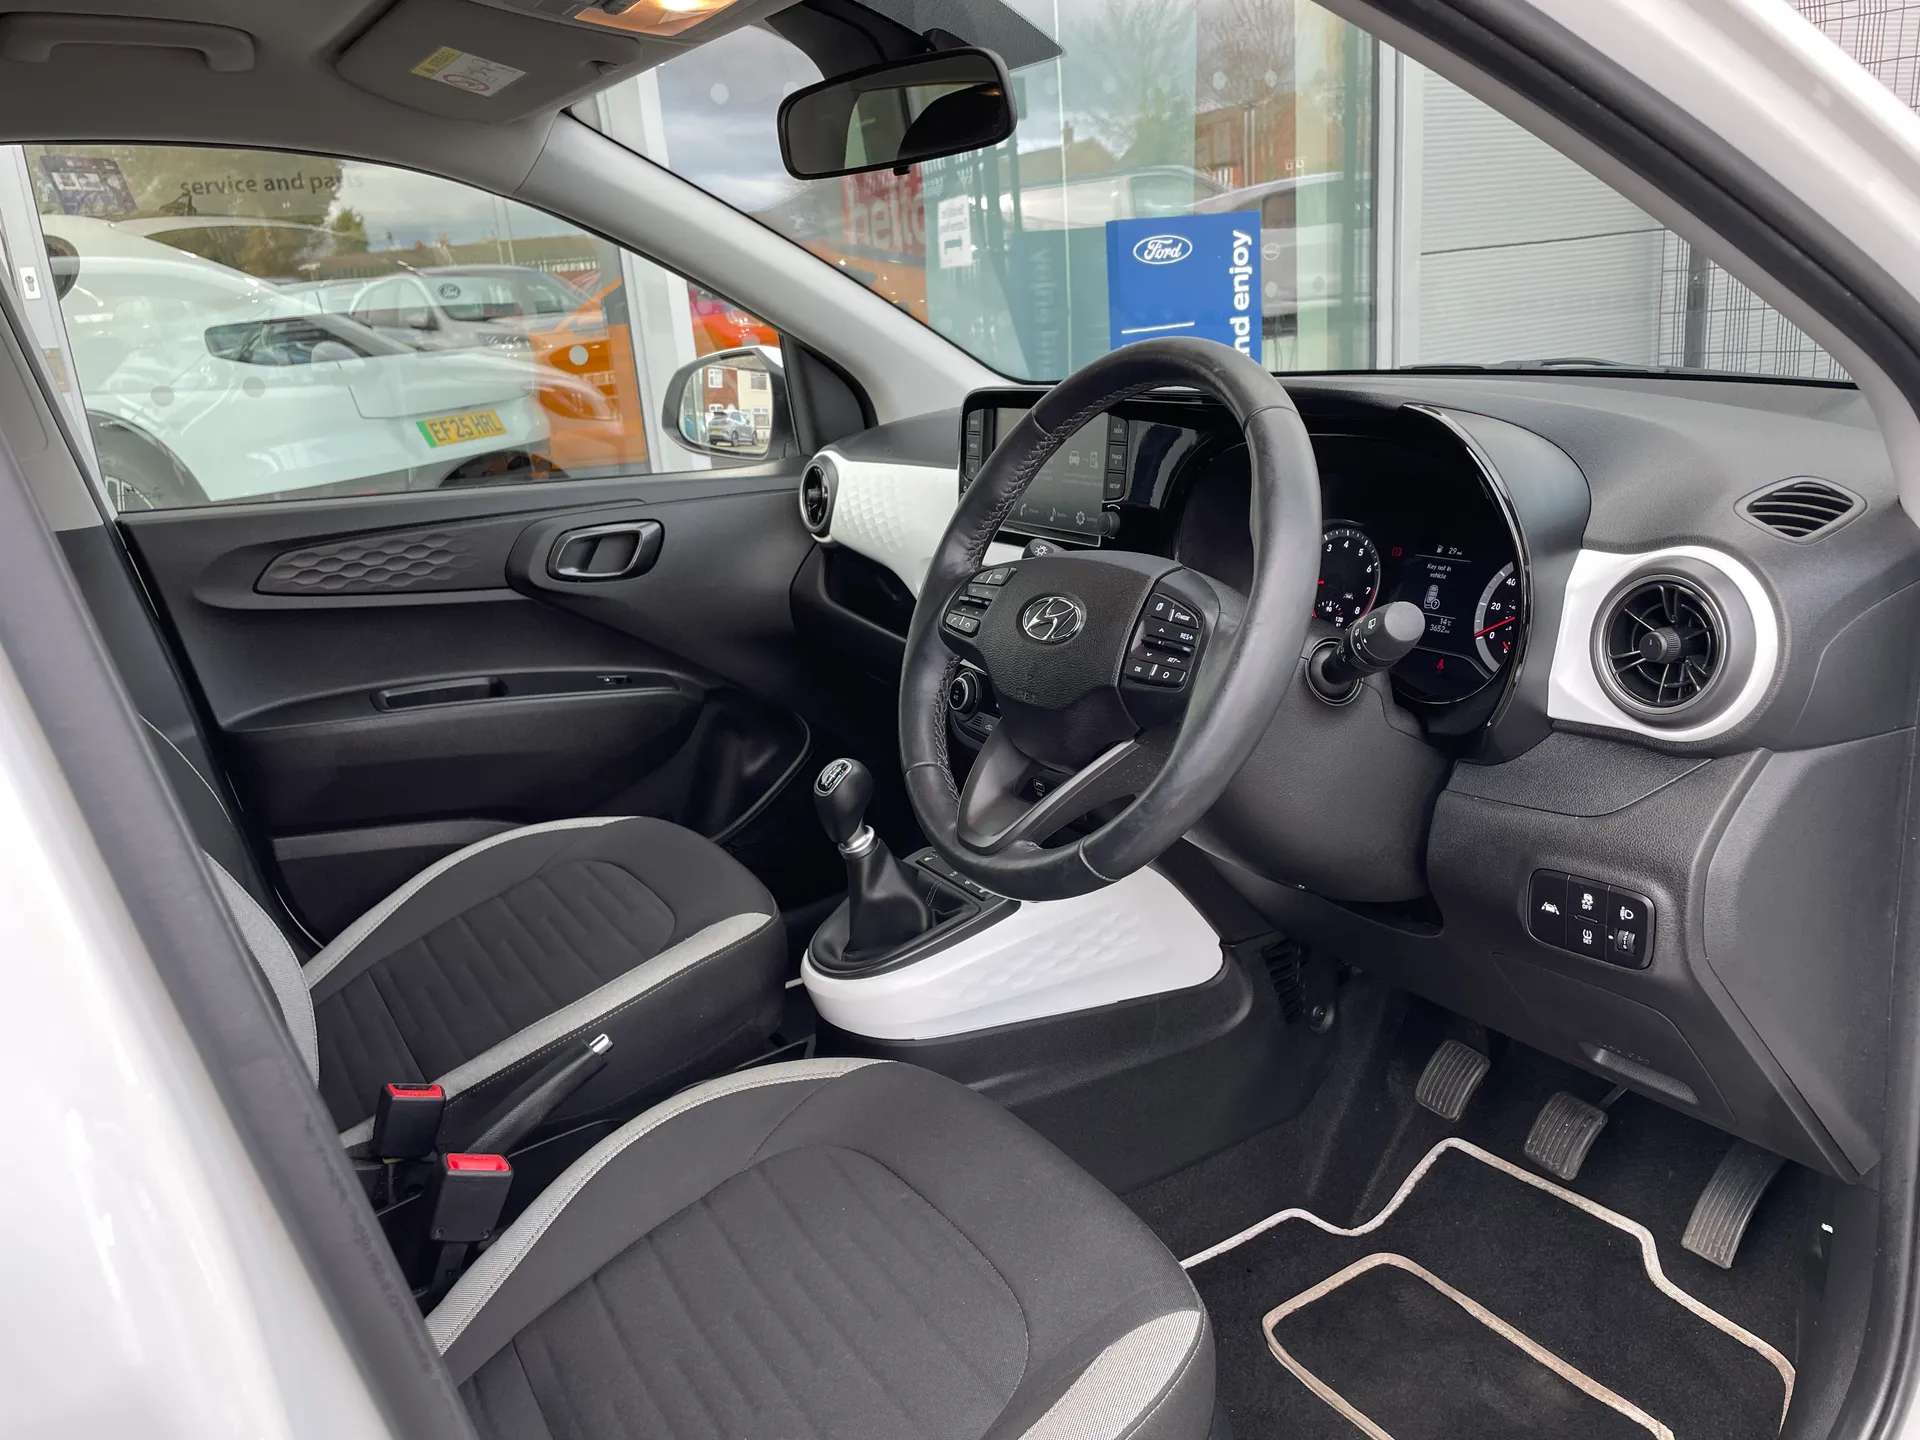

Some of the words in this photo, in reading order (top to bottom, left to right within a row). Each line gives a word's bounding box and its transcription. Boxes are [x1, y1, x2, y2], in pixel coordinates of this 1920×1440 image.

[180, 175, 258, 196] service
[263, 172, 304, 192] and
[1228, 229, 1253, 311] enjoy
[1229, 316, 1251, 357] nd
[429, 417, 474, 441] EF25
[1326, 543, 1333, 552] 3
[1343, 540, 1350, 548] 4
[1358, 548, 1364, 557] 5
[1366, 564, 1372, 573] 6
[1426, 563, 1437, 571] Key
[1506, 577, 1517, 586] 40
[1365, 586, 1371, 595] 7
[1354, 606, 1361, 615] 8
[1490, 602, 1501, 611] 20
[1489, 631, 1496, 639] 0
